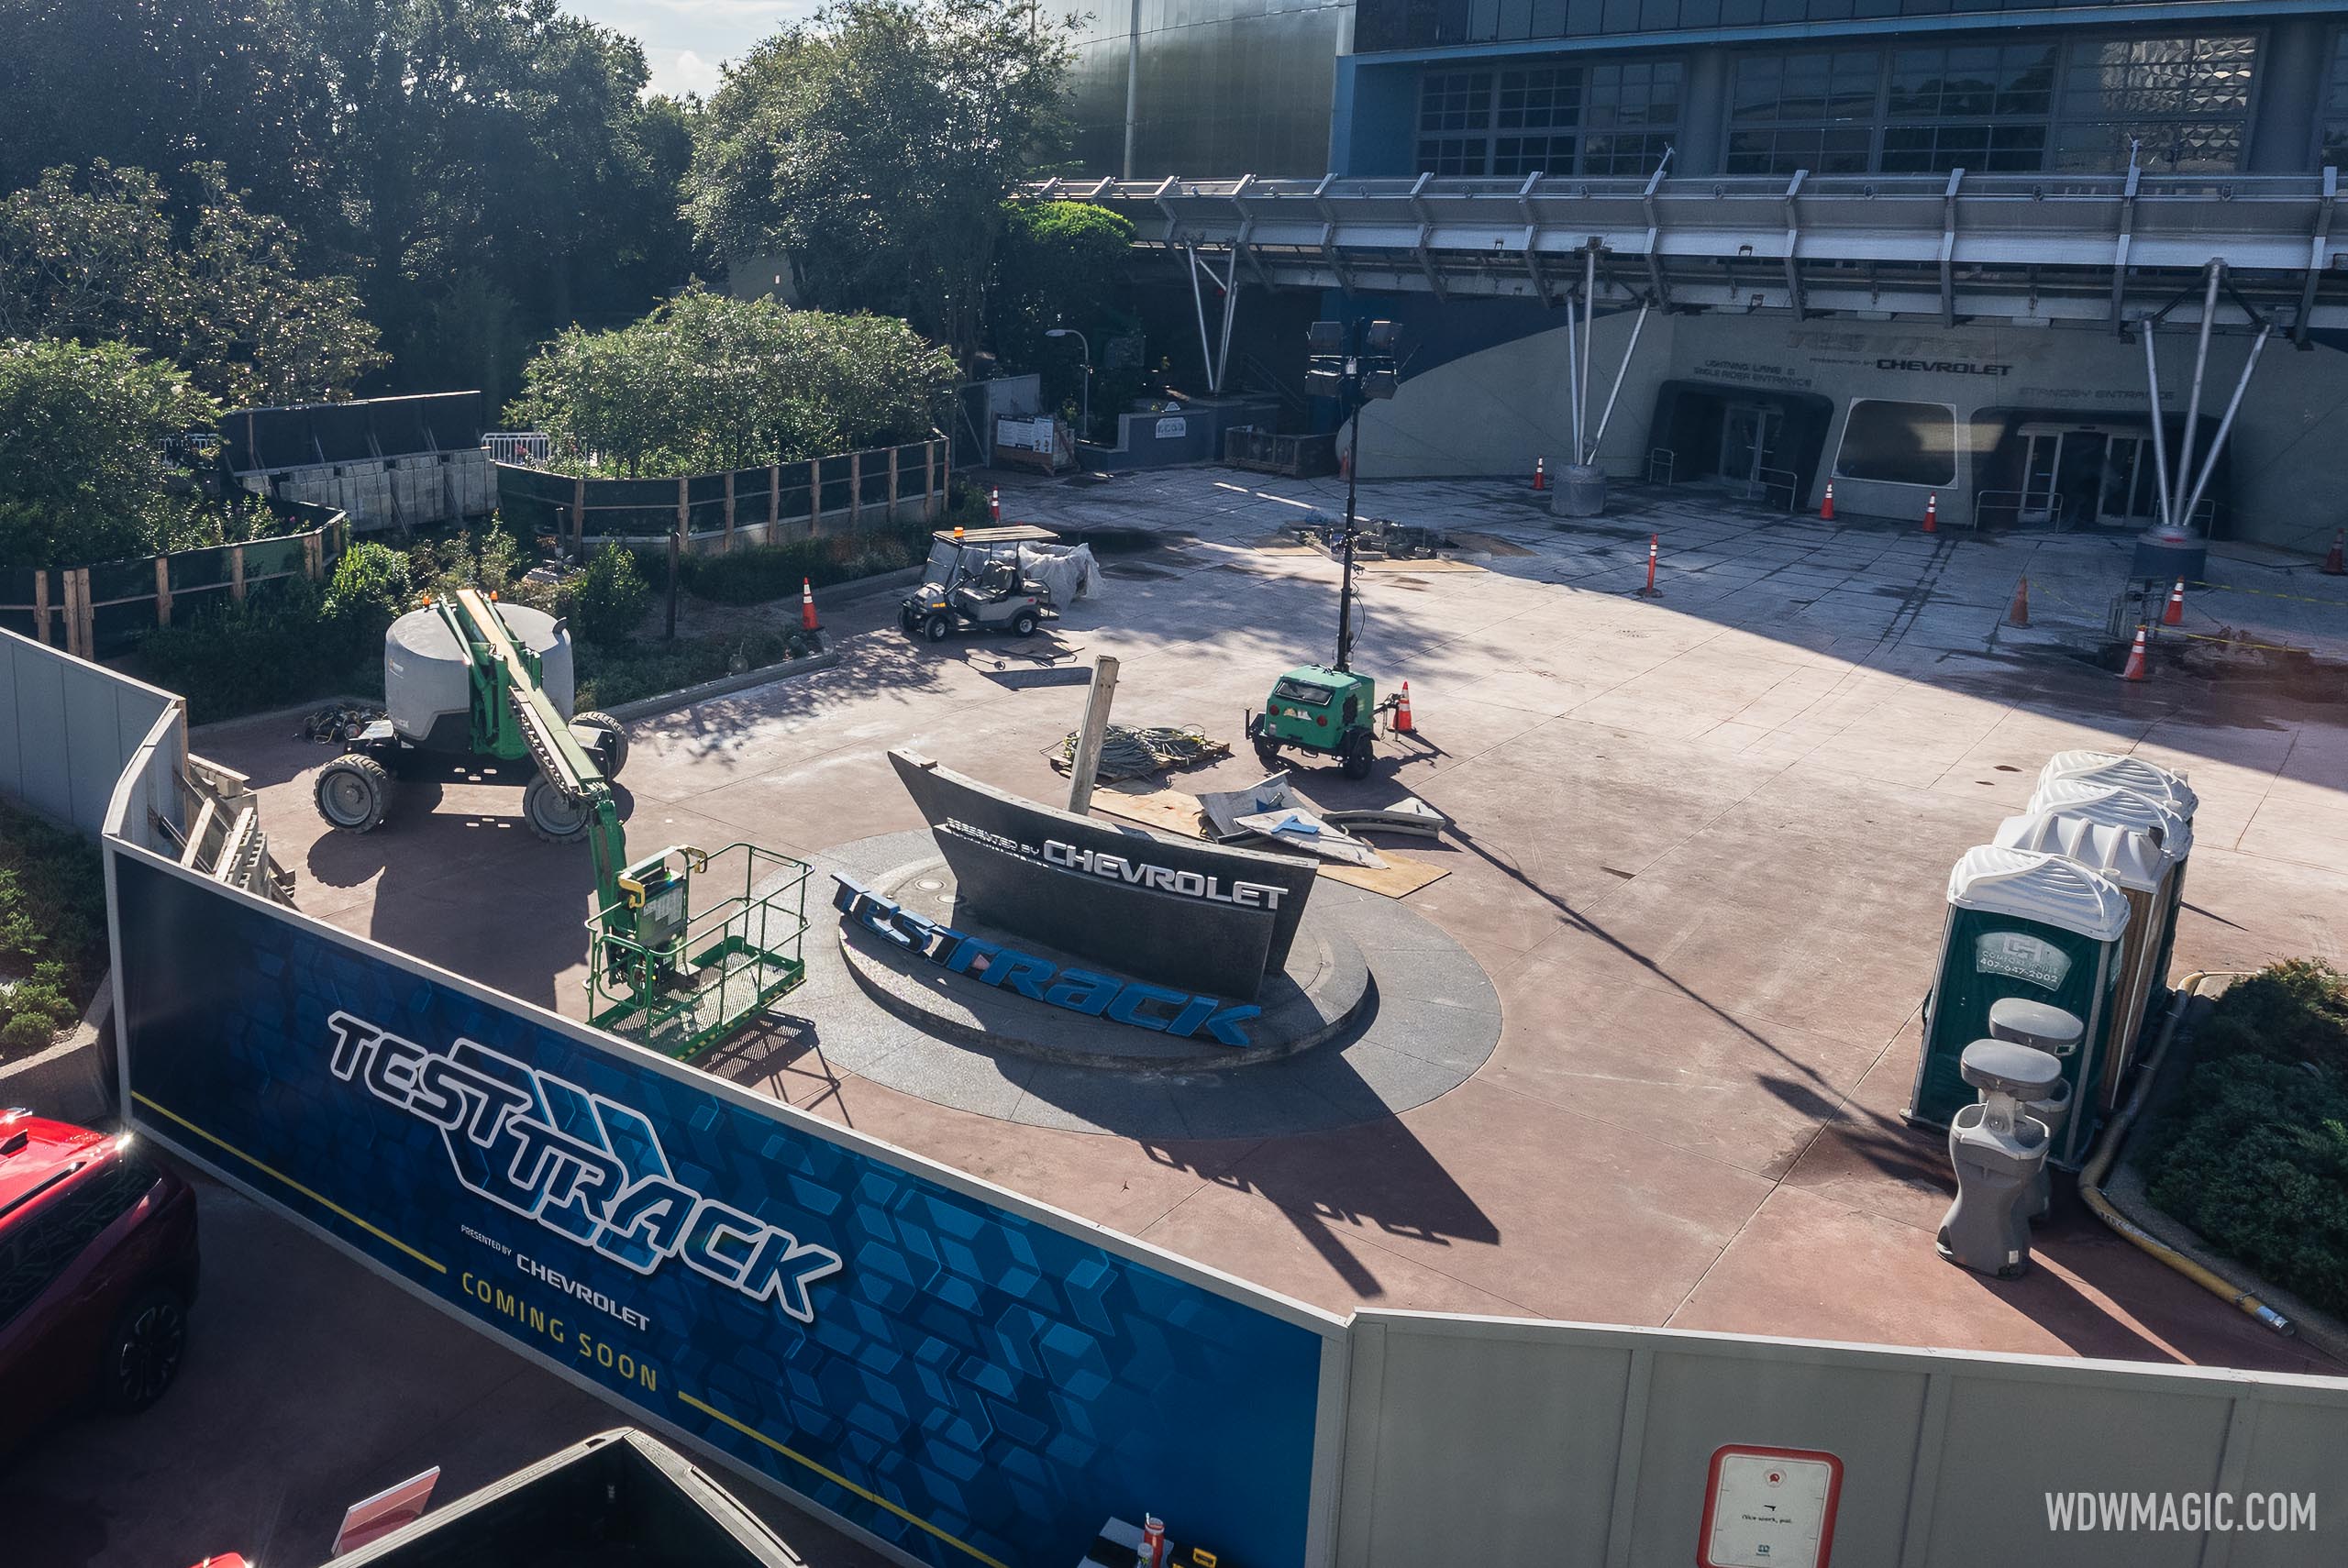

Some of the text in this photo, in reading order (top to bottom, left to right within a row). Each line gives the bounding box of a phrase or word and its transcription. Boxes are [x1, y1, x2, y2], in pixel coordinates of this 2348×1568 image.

[1750, 364, 1781, 374] LANE
[1877, 359, 2013, 376] CHEVROLET
[1020, 843, 1040, 856] BY
[1043, 838, 1289, 911] CHEVROLET
[1980, 957, 2058, 982] 407-647-2002
[327, 1010, 534, 1149] TEST
[506, 1116, 843, 1323] TRACK
[460, 1224, 650, 1331] PRESENTED BY CHEVROLET
[462, 1272, 657, 1392] COMING SOON
